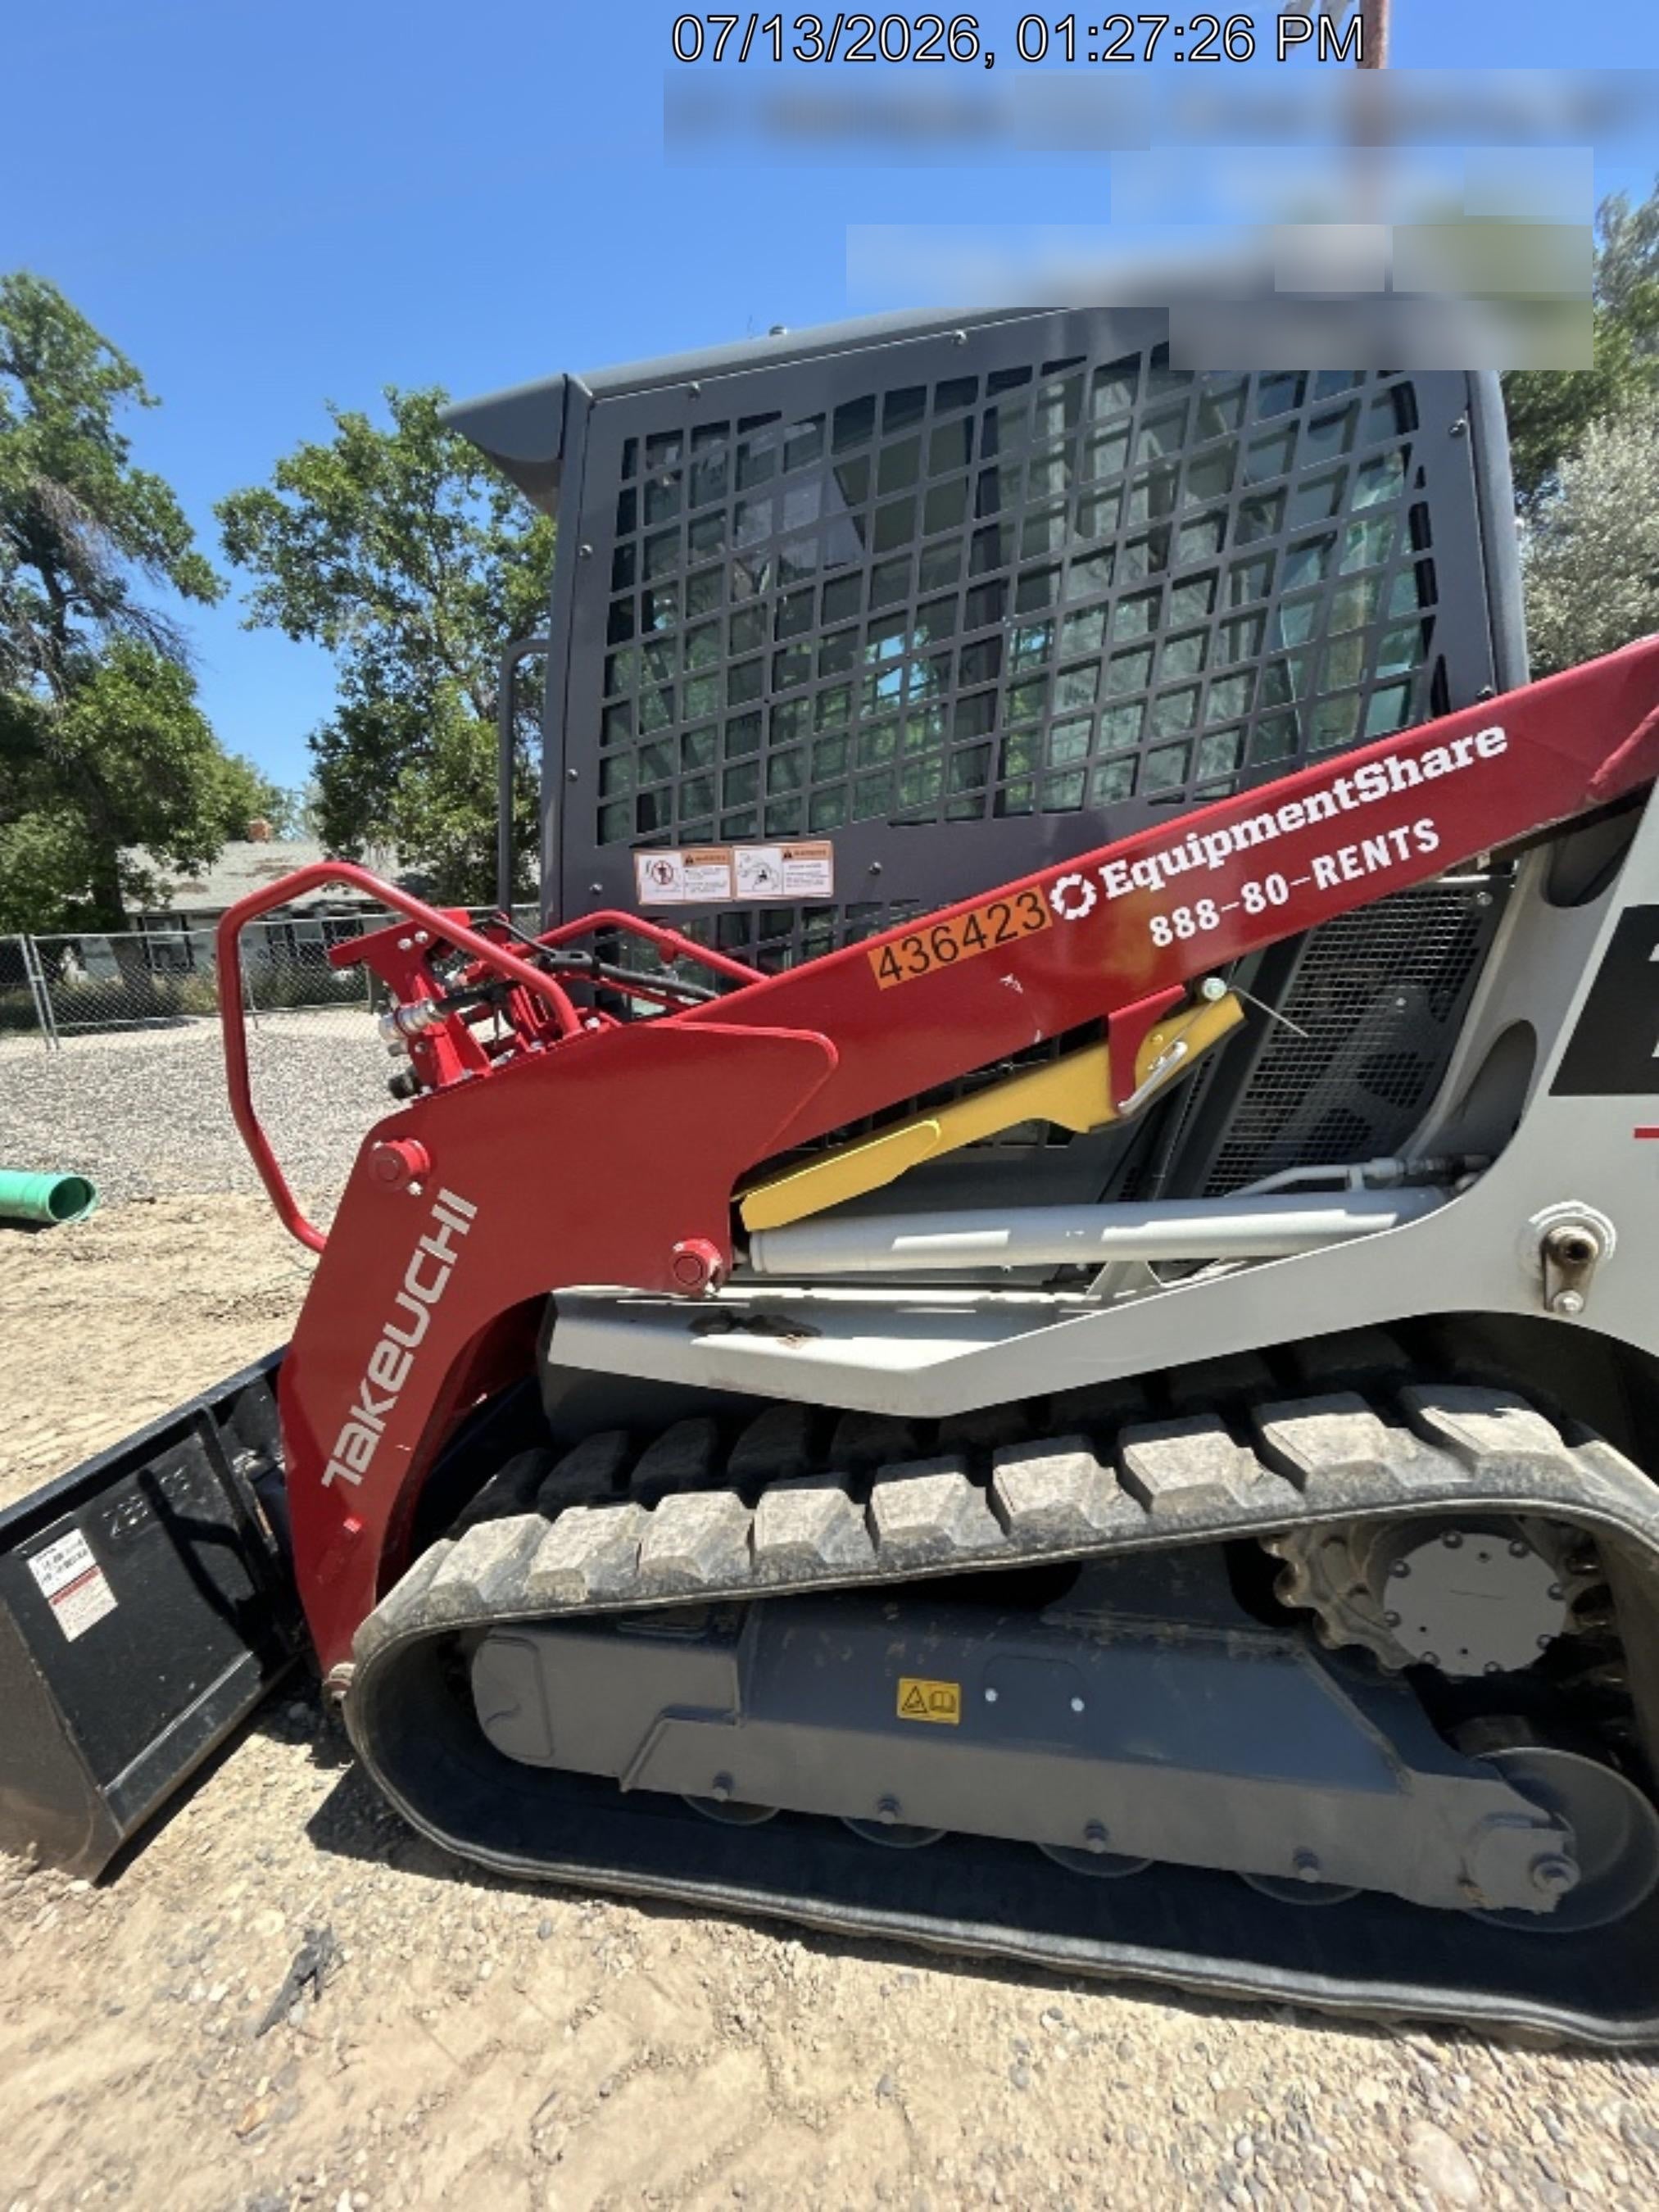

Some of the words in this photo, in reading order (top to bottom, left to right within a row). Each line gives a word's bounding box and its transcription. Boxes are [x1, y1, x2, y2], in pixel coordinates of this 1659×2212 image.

[1104, 725, 1508, 900] EquipmentShare
[877, 891, 1048, 984] 436423
[1149, 818, 1440, 947] 888-80-RENTS
